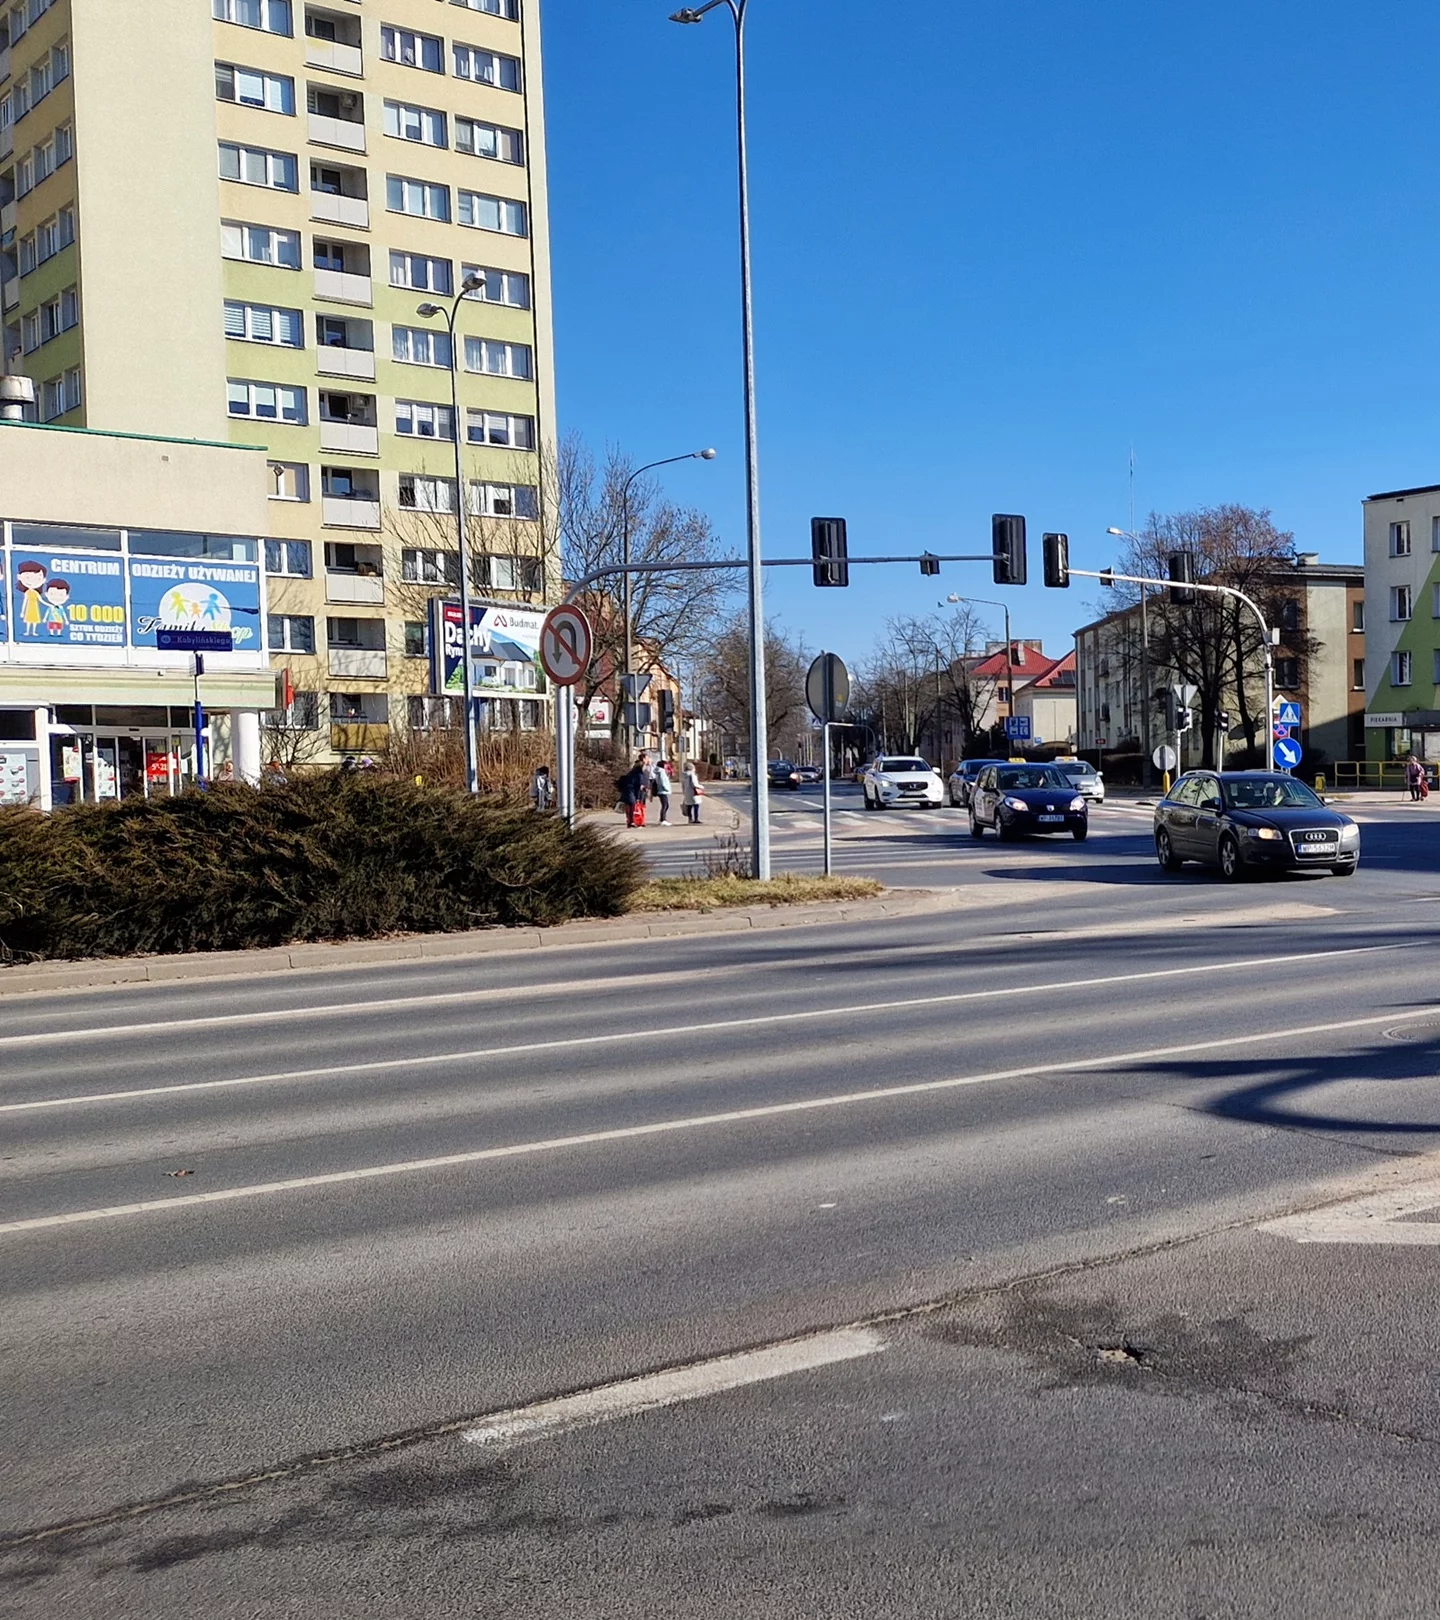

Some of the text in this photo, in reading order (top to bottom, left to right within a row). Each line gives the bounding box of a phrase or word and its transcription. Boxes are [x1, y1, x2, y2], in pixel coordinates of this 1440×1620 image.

[51, 559, 120, 576] CENTRUM
[131, 564, 256, 583] ODZIEŻY UŻYWANEJ
[67, 604, 124, 623] 10 000
[69, 632, 84, 641] CO
[177, 635, 230, 645] Kobylińskiego
